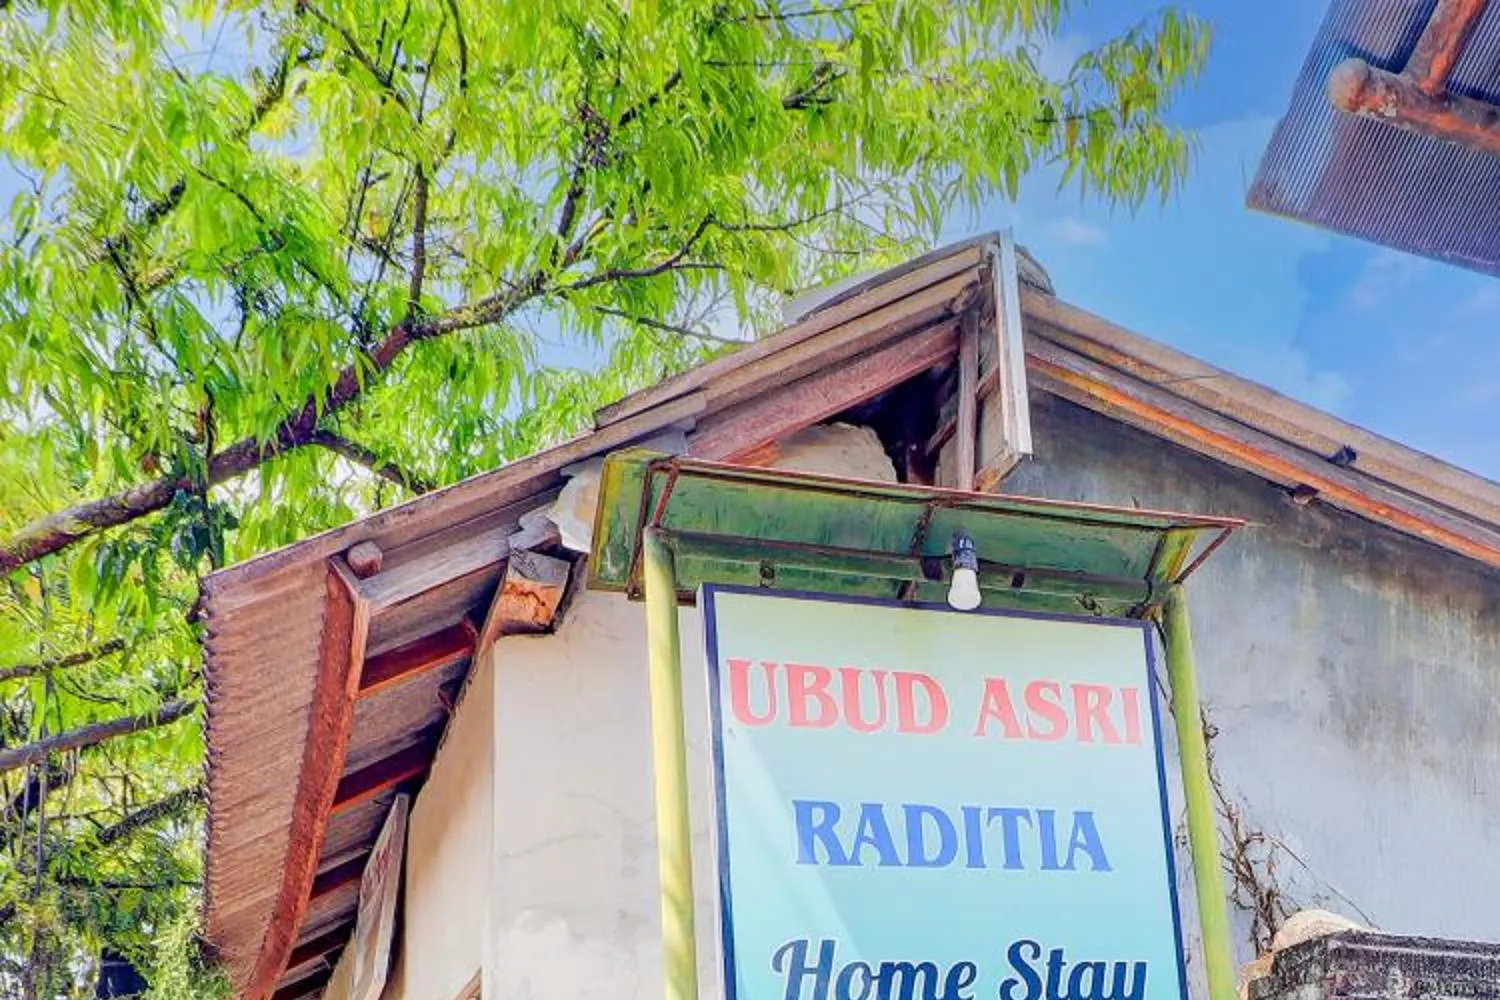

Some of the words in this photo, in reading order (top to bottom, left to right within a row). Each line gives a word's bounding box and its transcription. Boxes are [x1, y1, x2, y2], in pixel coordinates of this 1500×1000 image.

[726, 659, 949, 733] UBUD
[974, 676, 1142, 746] ASRI
[792, 800, 1112, 872] RADITIA
